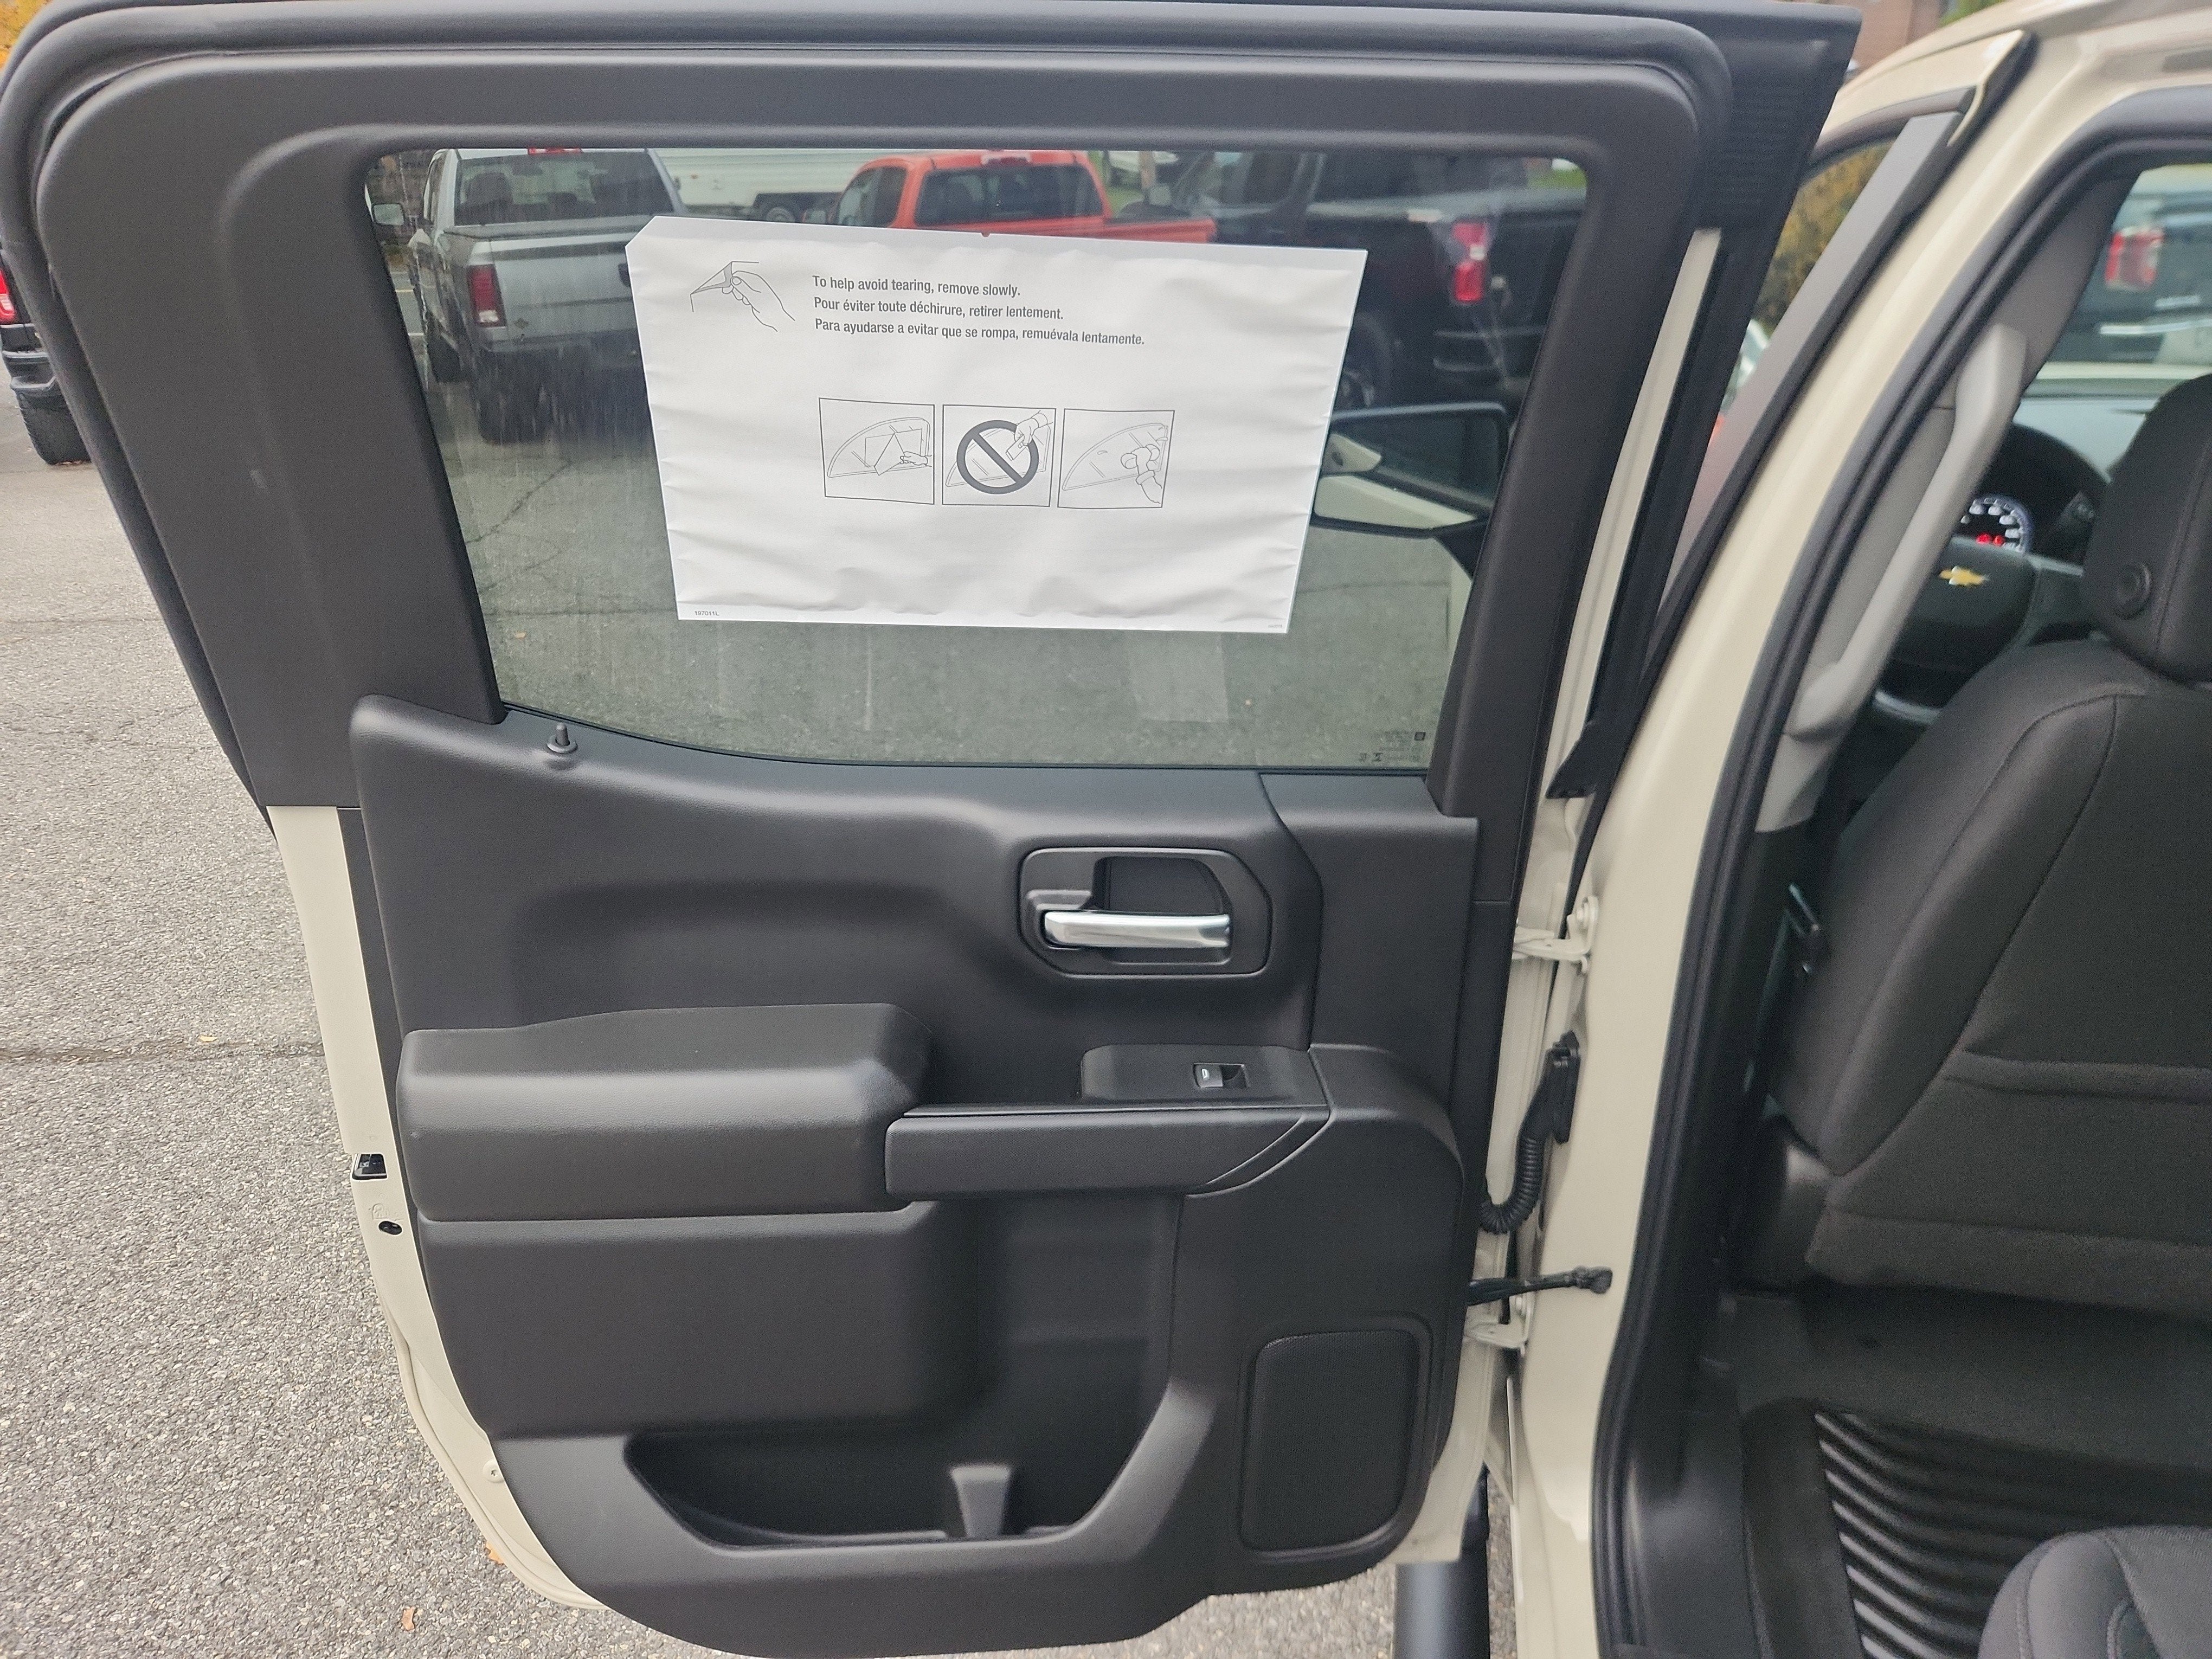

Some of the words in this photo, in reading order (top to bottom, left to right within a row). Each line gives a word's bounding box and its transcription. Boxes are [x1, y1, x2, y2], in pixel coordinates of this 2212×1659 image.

[812, 275, 827, 287] To
[830, 276, 854, 292] help
[858, 278, 888, 291] avoid
[891, 279, 934, 294] tearing,
[938, 283, 979, 295] remove
[982, 284, 1020, 298] slowly.
[814, 297, 840, 310] Pour
[843, 299, 876, 312] éviter
[877, 300, 906, 312] toute
[910, 300, 966, 318] déchirure,
[969, 305, 1004, 317] retirer
[1006, 305, 1063, 320] lentement.
[815, 318, 841, 331] Para
[844, 321, 894, 335] ayudarse
[897, 324, 905, 333] a
[908, 323, 939, 336] evitar
[941, 327, 962, 339] que
[965, 329, 978, 338] se
[981, 329, 1019, 340] rompa,
[1022, 328, 1078, 342] remuévala
[1082, 331, 1144, 345] lentamente.
